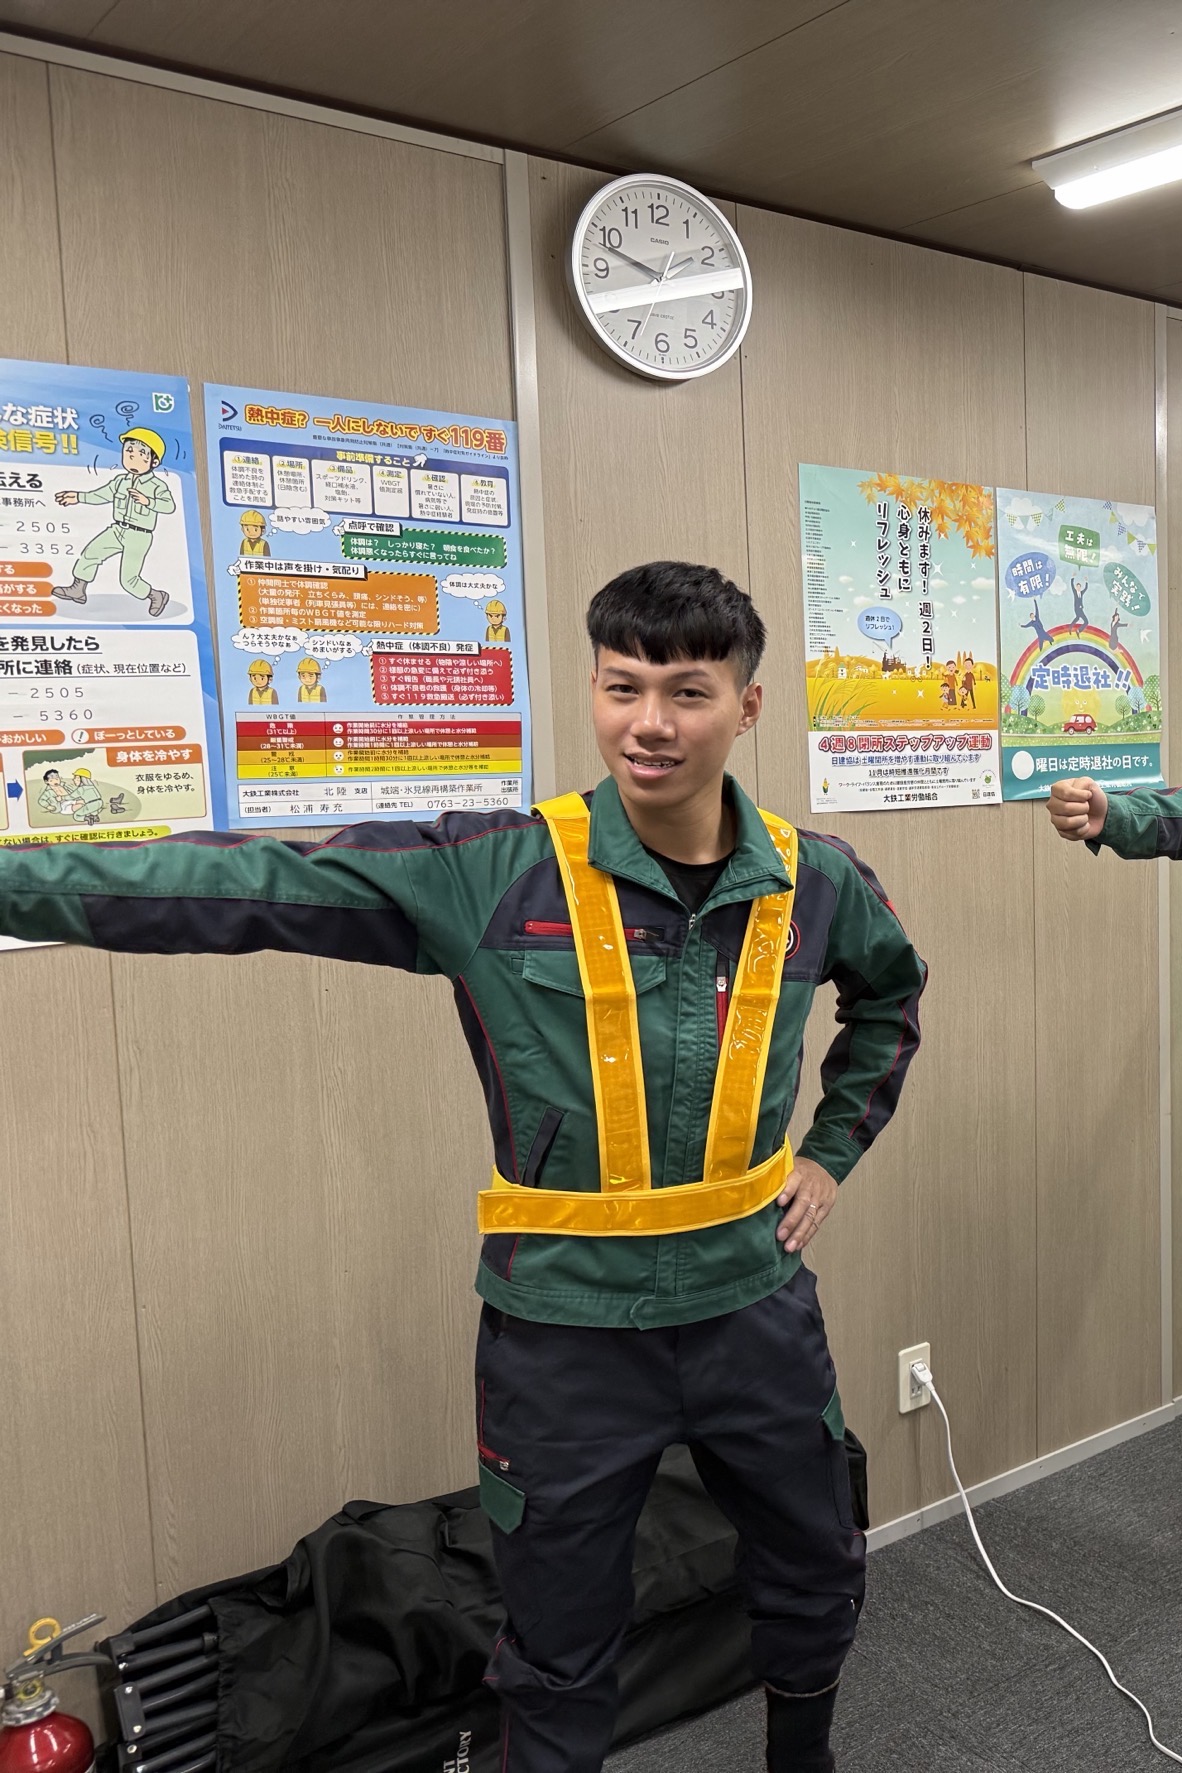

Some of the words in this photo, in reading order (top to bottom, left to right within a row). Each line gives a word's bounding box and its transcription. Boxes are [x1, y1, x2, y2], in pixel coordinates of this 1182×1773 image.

[621, 206, 639, 229] 11
[648, 203, 670, 226] 12
[599, 226, 623, 249] 10
[683, 219, 690, 239] 1
[650, 237, 670, 246] CASIO
[700, 246, 715, 267] 2
[593, 258, 610, 279] 9
[627, 319, 642, 340] 7
[701, 309, 717, 330] 4
[654, 332, 670, 353] 6
[683, 328, 698, 349] 5
[0, 402, 79, 430] な症状
[245, 404, 310, 428] 熱中症？
[336, 450, 412, 467] 事前準備すること
[0, 496, 47, 508] 事務所へ
[348, 520, 395, 533] 点呼で確認
[897, 504, 912, 592] 心身ともに
[1064, 530, 1095, 548] 工夫は
[876, 502, 892, 600] リフレッシュ
[917, 506, 932, 594] 休みます！
[1063, 544, 1097, 564] 無限！
[244, 560, 360, 576] 作業中は声を掛け・気配り
[1011, 558, 1044, 578] 時間は
[0, 583, 37, 595] がする
[1017, 573, 1051, 596] 有限！
[1110, 579, 1141, 612] 実践！
[1031, 664, 1133, 691] 定時退社!!
[0, 733, 47, 744] おかしい
[94, 730, 176, 741] ぼーっとしている
[818, 733, 992, 754] 4週8閉所ステップアップ運動
[116, 749, 193, 763] 身体を冷やす
[1035, 755, 1154, 774] 曜日は定時退社の日です。
[135, 772, 195, 783] 衣服をゆるめ、
[136, 783, 196, 795] 身体を冷やす。
[242, 789, 300, 798] 大鉄工業株式会社
[324, 786, 347, 797] 北陸
[354, 788, 368, 796] 支店
[883, 792, 939, 804] 大鉄工業労働組合
[426, 797, 509, 810] 0763-23-5360
